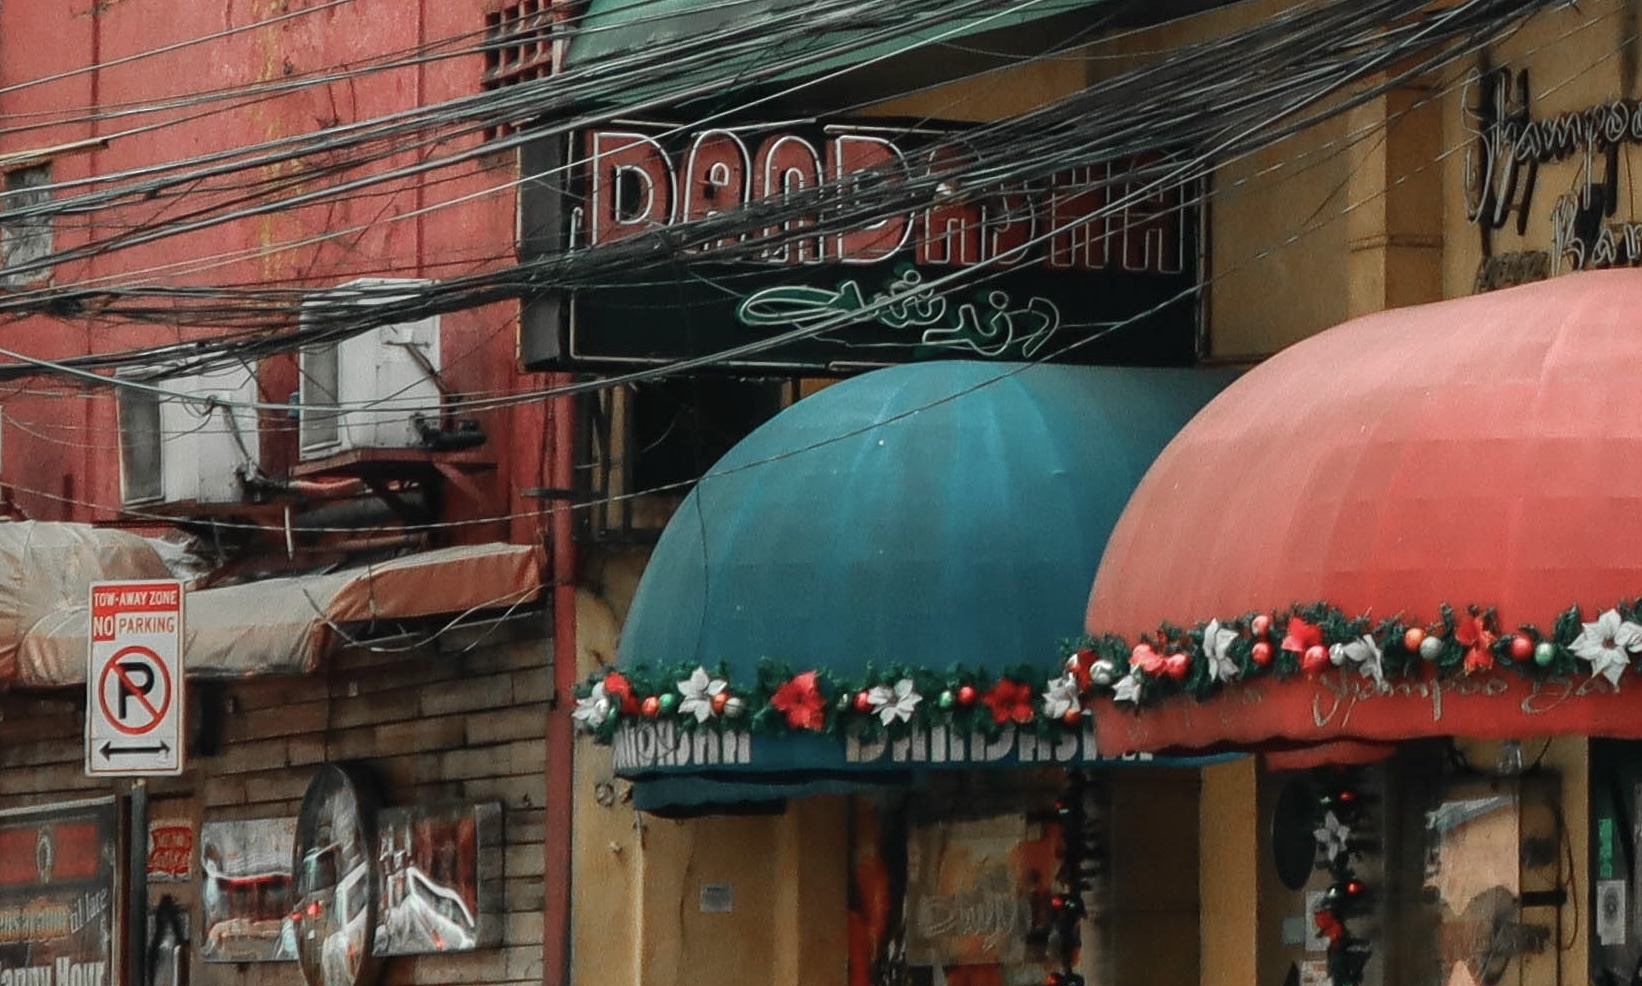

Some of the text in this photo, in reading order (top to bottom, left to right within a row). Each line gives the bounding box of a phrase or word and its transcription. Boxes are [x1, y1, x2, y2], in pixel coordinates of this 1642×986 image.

[94, 590, 177, 608] TOW-AWAY ZONE
[93, 616, 175, 636] NO PARKING
